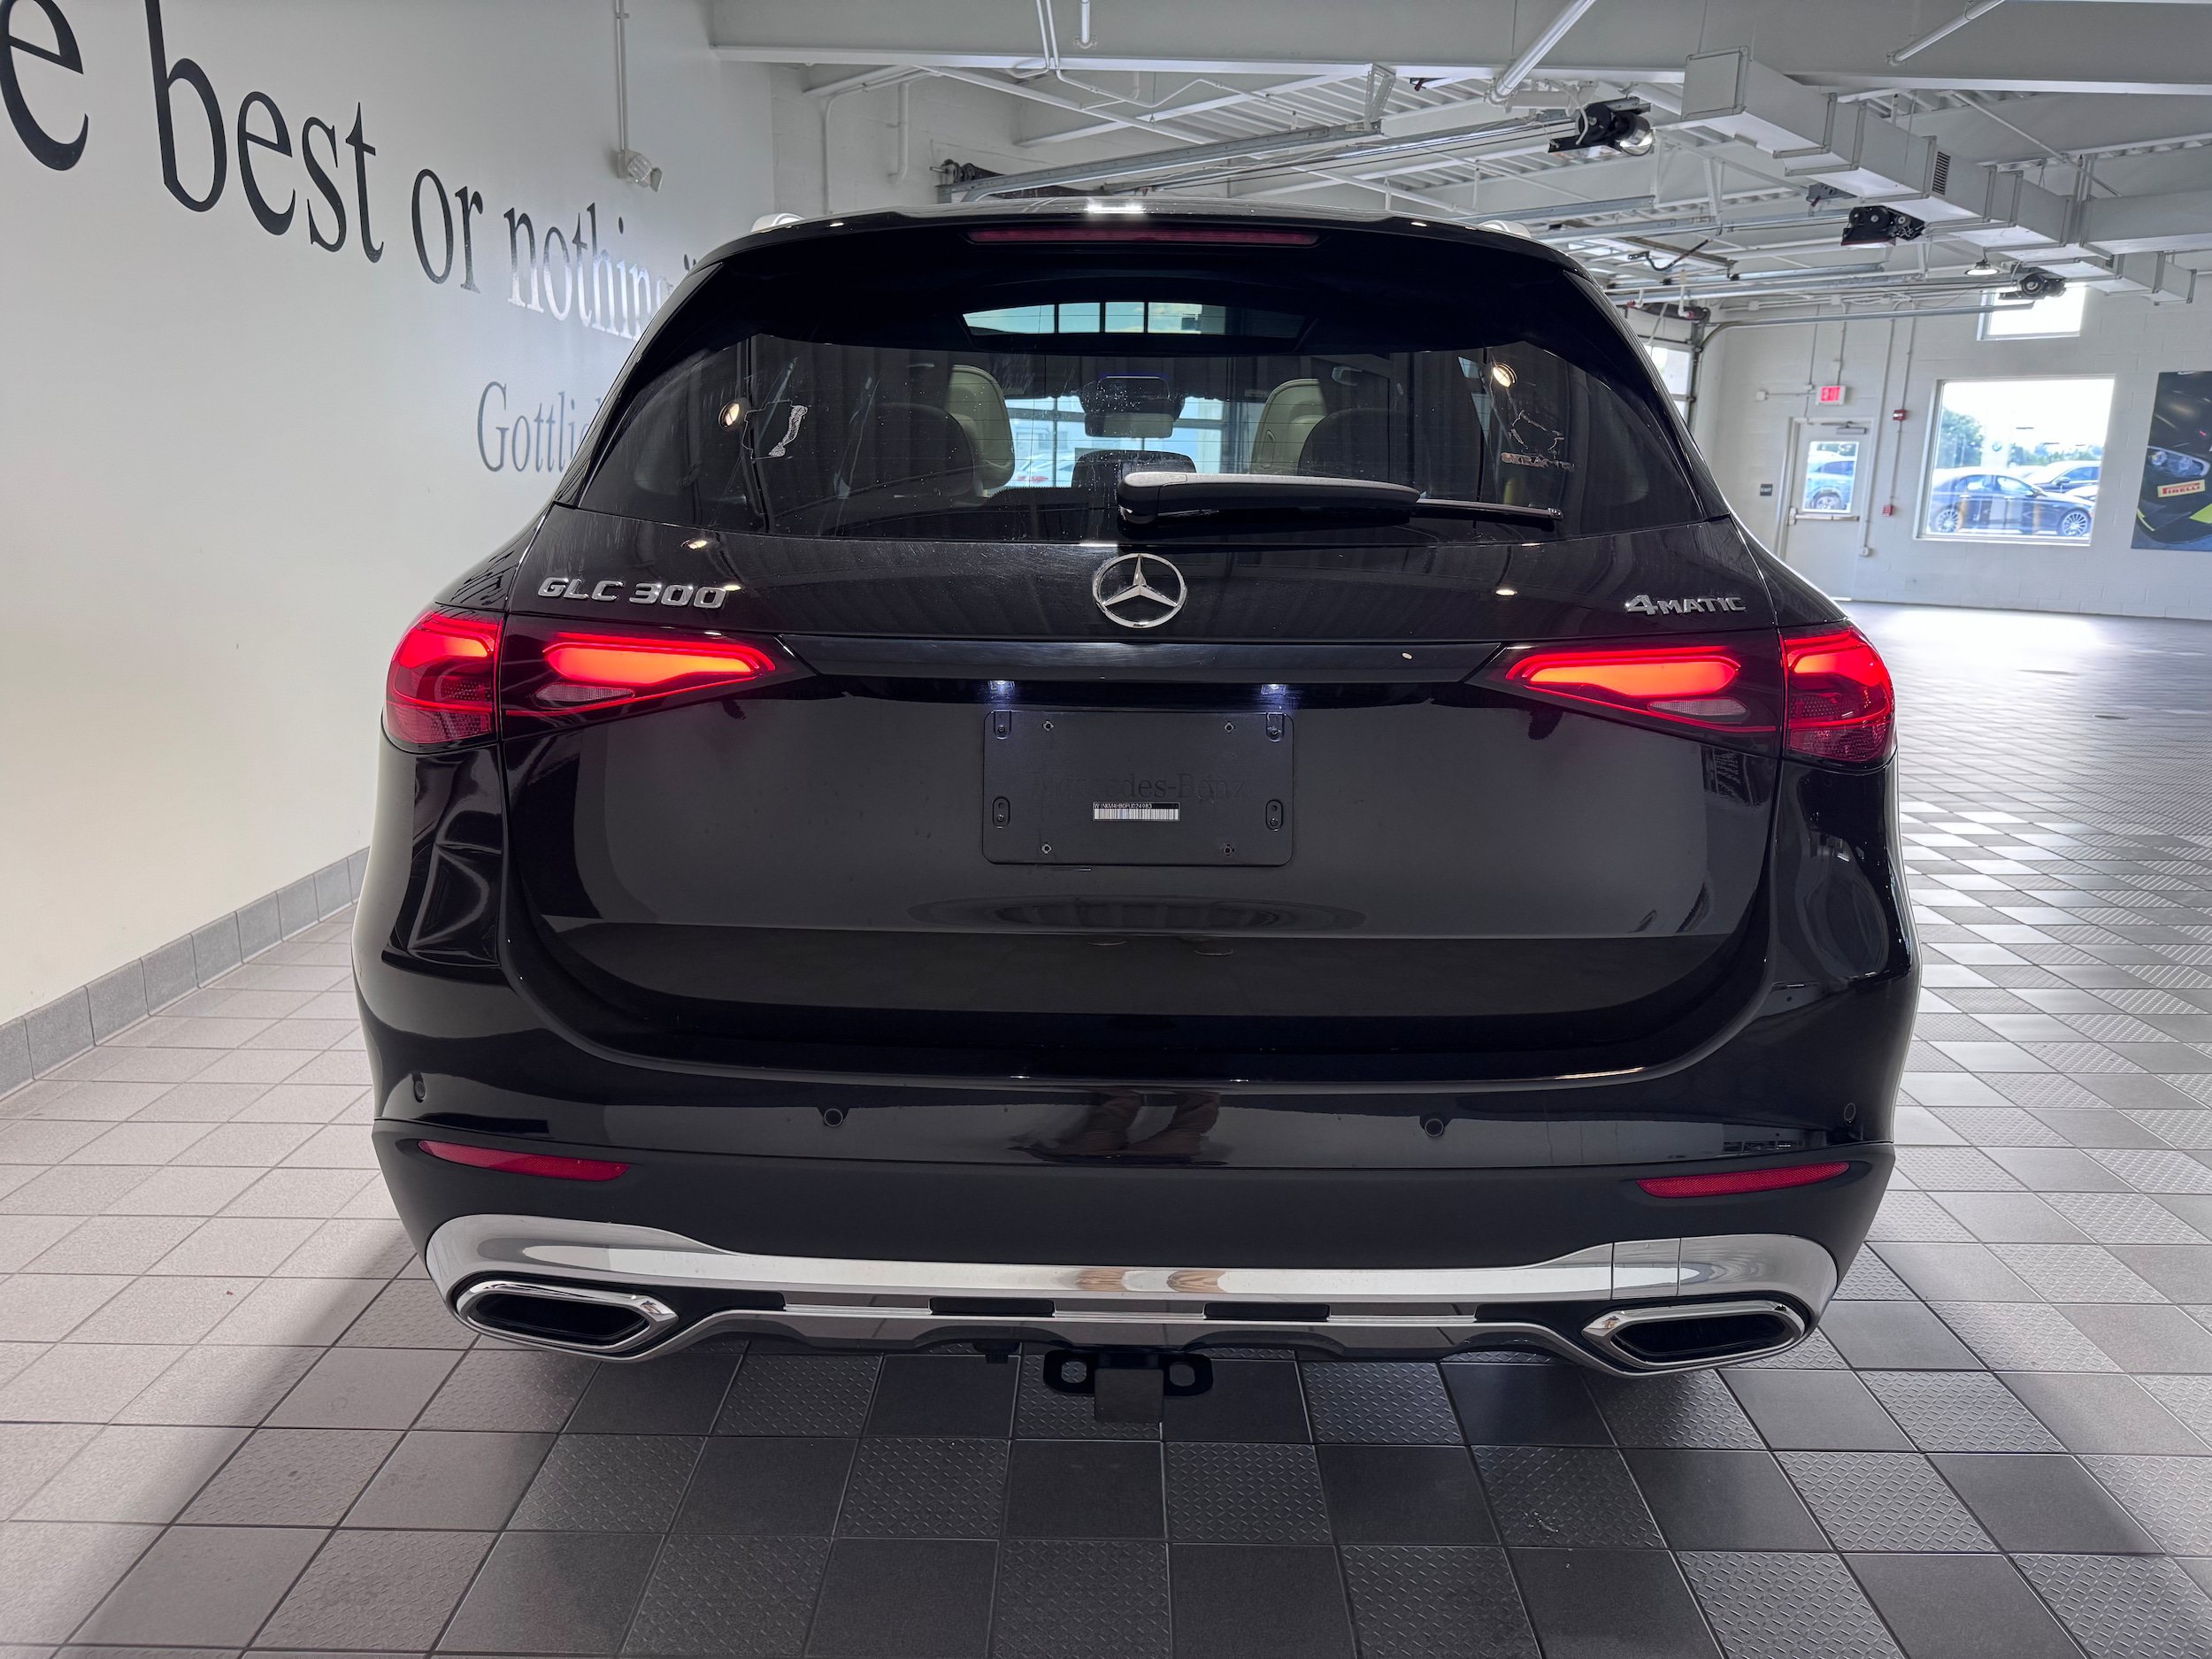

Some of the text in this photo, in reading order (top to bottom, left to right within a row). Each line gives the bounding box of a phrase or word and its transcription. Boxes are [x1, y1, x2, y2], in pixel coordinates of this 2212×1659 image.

[144, 0, 385, 263] best
[411, 168, 483, 294] or
[1820, 387, 1841, 402] EXIT
[477, 380, 603, 473] Gottli
[537, 577, 726, 609] GLC 300
[1624, 595, 1747, 616] 4MATIC
